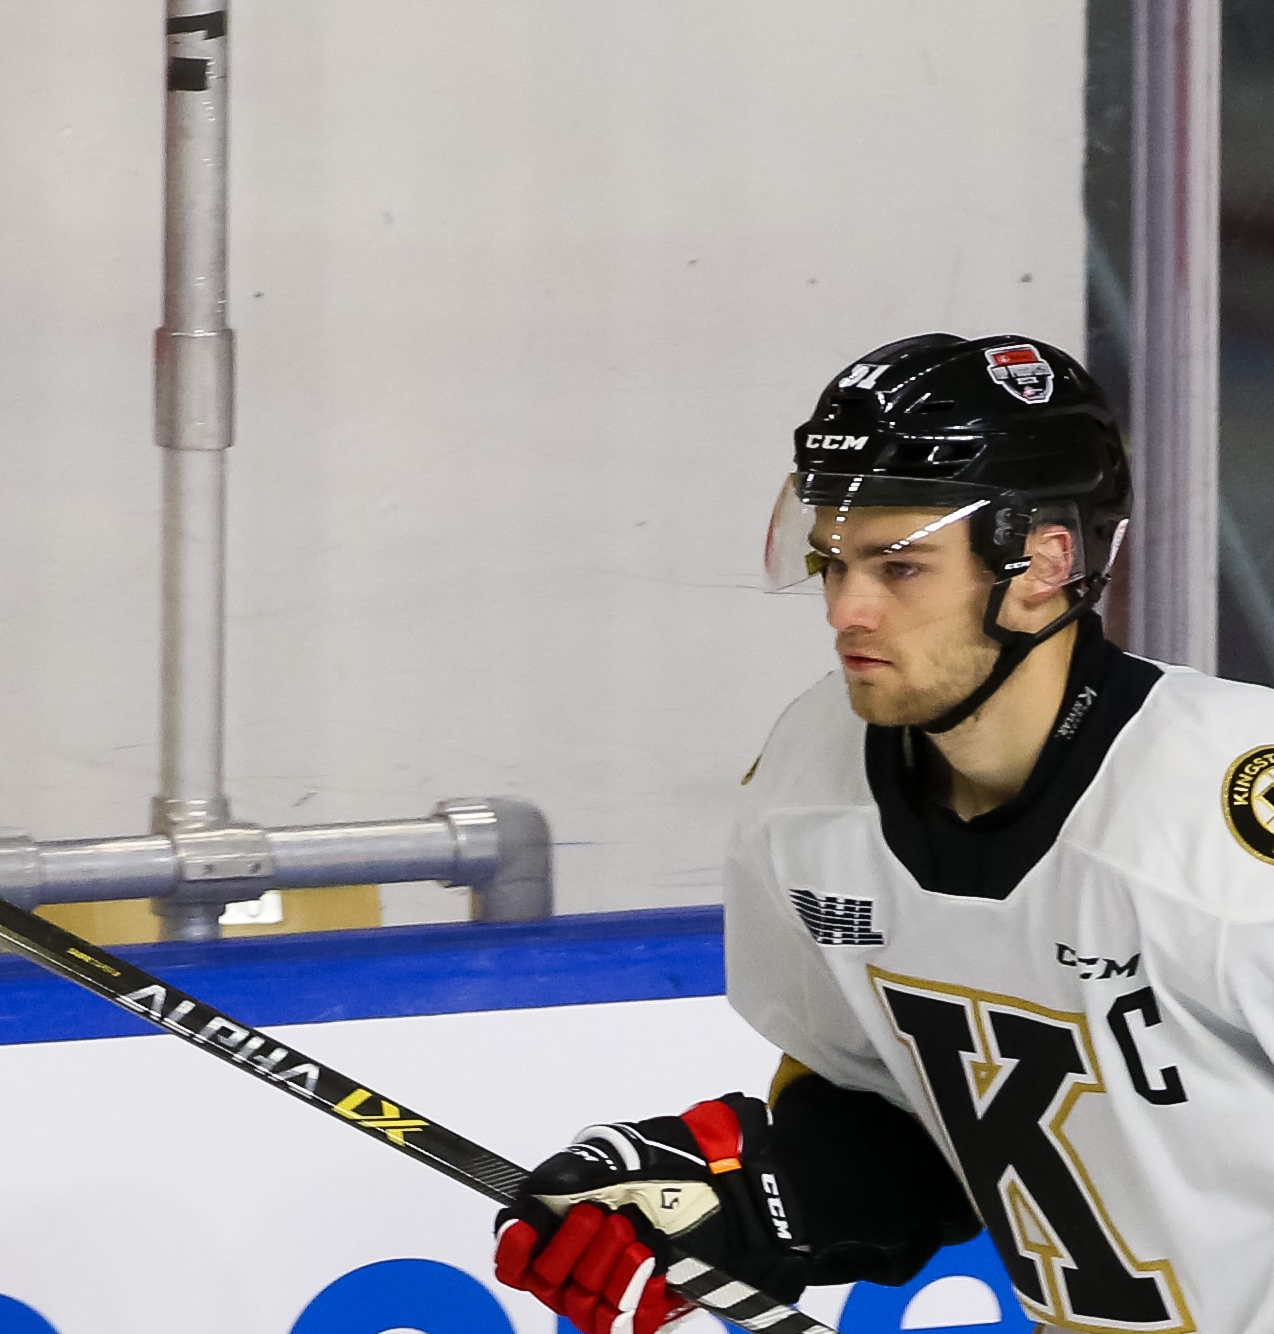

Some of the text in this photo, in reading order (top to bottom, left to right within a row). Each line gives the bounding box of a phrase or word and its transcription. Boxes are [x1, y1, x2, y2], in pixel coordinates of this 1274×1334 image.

[806, 434, 869, 450] CCM
[116, 984, 321, 1099] ALPHA
[1106, 986, 1189, 1106] C
[761, 1173, 793, 1240] CCM
